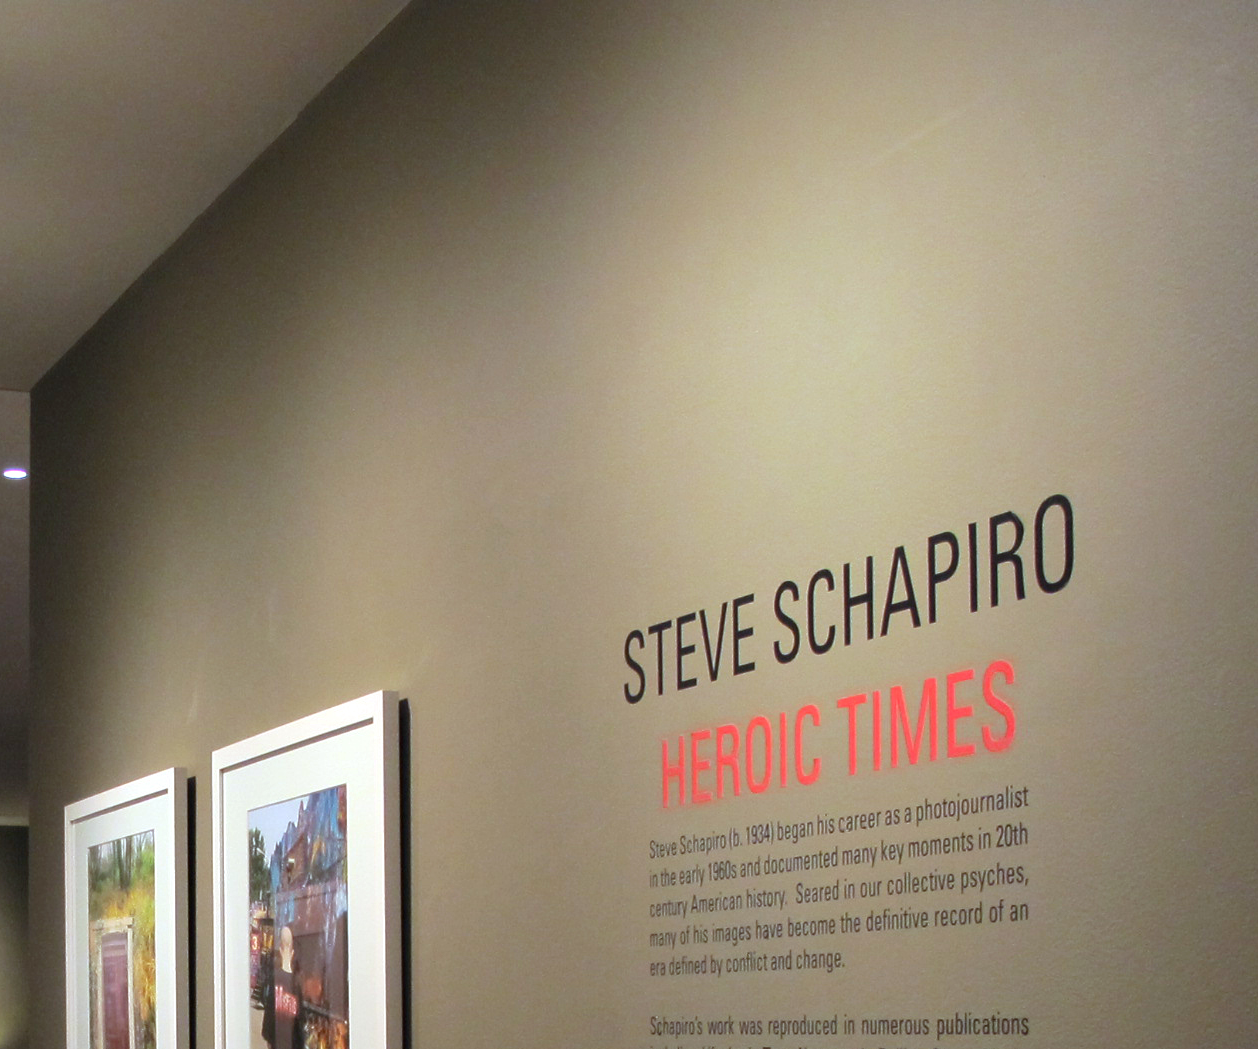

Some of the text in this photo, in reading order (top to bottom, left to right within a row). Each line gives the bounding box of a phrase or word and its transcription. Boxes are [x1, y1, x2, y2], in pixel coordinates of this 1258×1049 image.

[623, 493, 1075, 705] STEVE SCHAPIRO
[661, 660, 1017, 810] HEROIC TIMES
[649, 785, 1029, 859] Steve Schapiro (b. 1934) began his career as a photojournalist
[649, 822, 1028, 888] in the early 1960s and documented many key moments in 20th
[649, 862, 1029, 918] century American history. Seared in our collective psyches,
[649, 899, 1029, 949] many of his images have become the definitive record of an
[649, 949, 845, 977] era defined by conflict and change.
[650, 1012, 1029, 1041] Schapiro's work was reproduced in numerous publications
